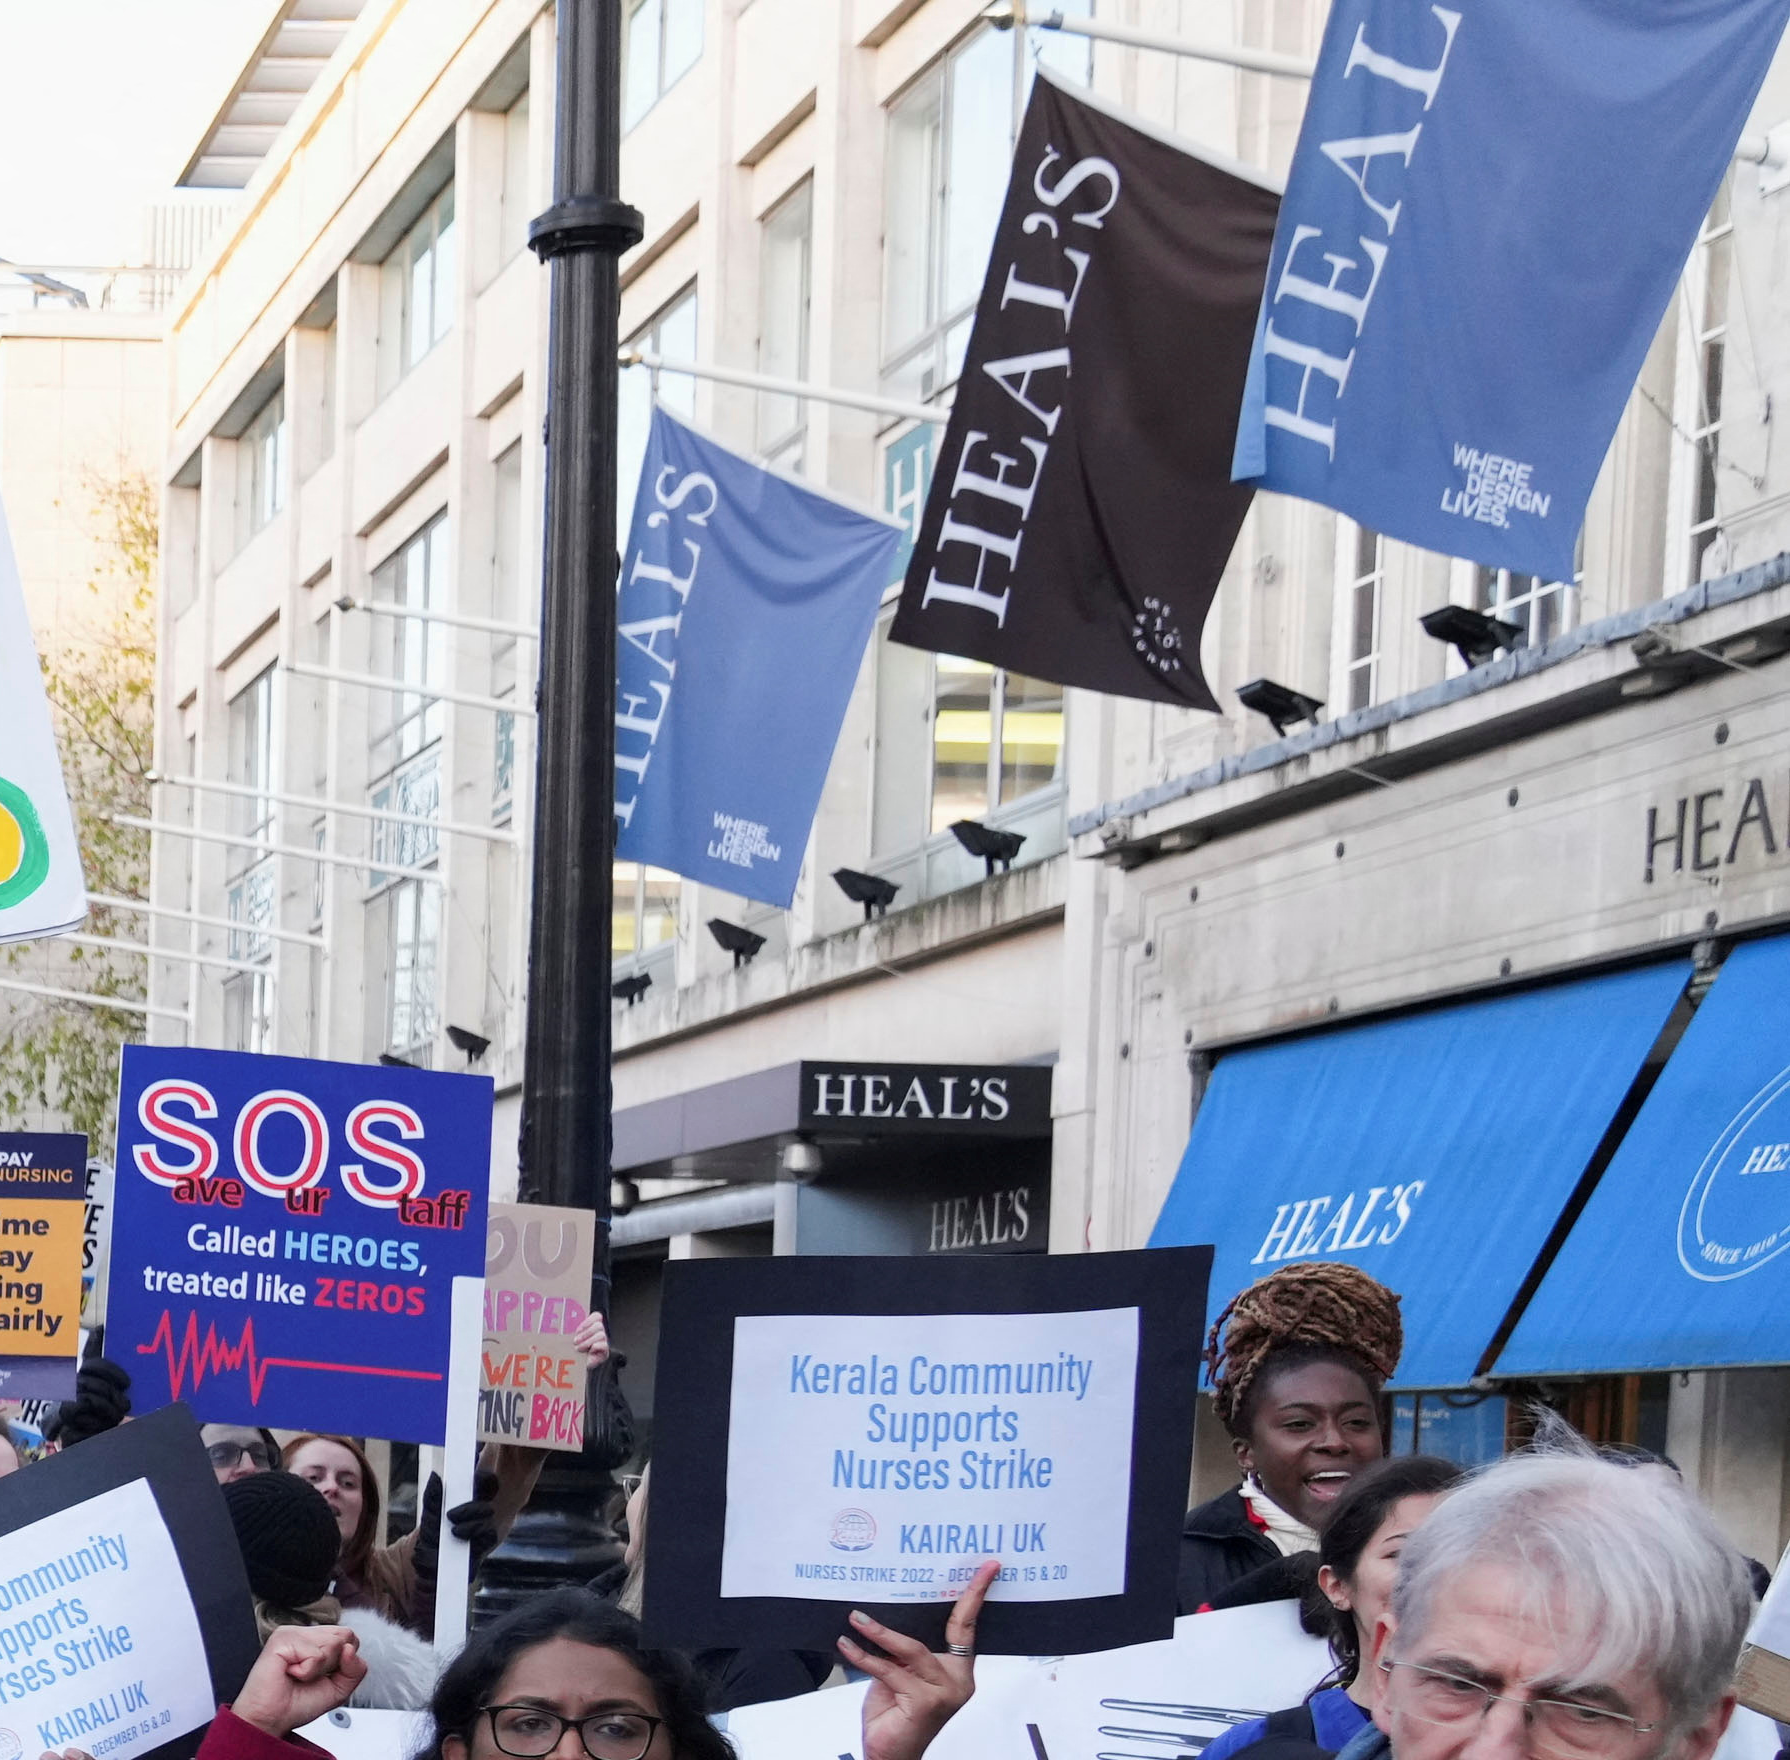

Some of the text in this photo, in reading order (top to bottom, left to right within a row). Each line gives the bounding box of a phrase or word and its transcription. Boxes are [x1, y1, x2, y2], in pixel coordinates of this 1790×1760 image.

[922, 143, 1121, 629] HEAL'S
[1453, 442, 1533, 488] WHERE
[1441, 488, 1509, 529] LIVES.
[1466, 470, 1551, 517] DESIGN
[714, 811, 769, 839] WHERE
[1644, 779, 1790, 883] HEA
[813, 1073, 1010, 1122] HEAL'S
[131, 1078, 426, 1209] SOS
[173, 1176, 471, 1229] ave taff
[930, 1187, 1030, 1251] HEAL'S
[1251, 1178, 1425, 1264] HEAL'S
[187, 1223, 427, 1277] Called HEROES,
[143, 1265, 426, 1316] treated like ZEROS
[789, 1352, 1093, 1400] Kerala Community
[528, 1393, 586, 1445] BACK
[867, 1403, 1019, 1451] Supports
[832, 1448, 1053, 1490] Nurses Strike
[900, 1523, 1047, 1553] KAIRALI UK
[794, 1564, 1068, 1583] NURSES STRIKE 2022 15 20
[54, 1624, 133, 1677] Strike
[37, 1680, 149, 1749] KAIRALI UK
[91, 1726, 138, 1757] DECEMBER
